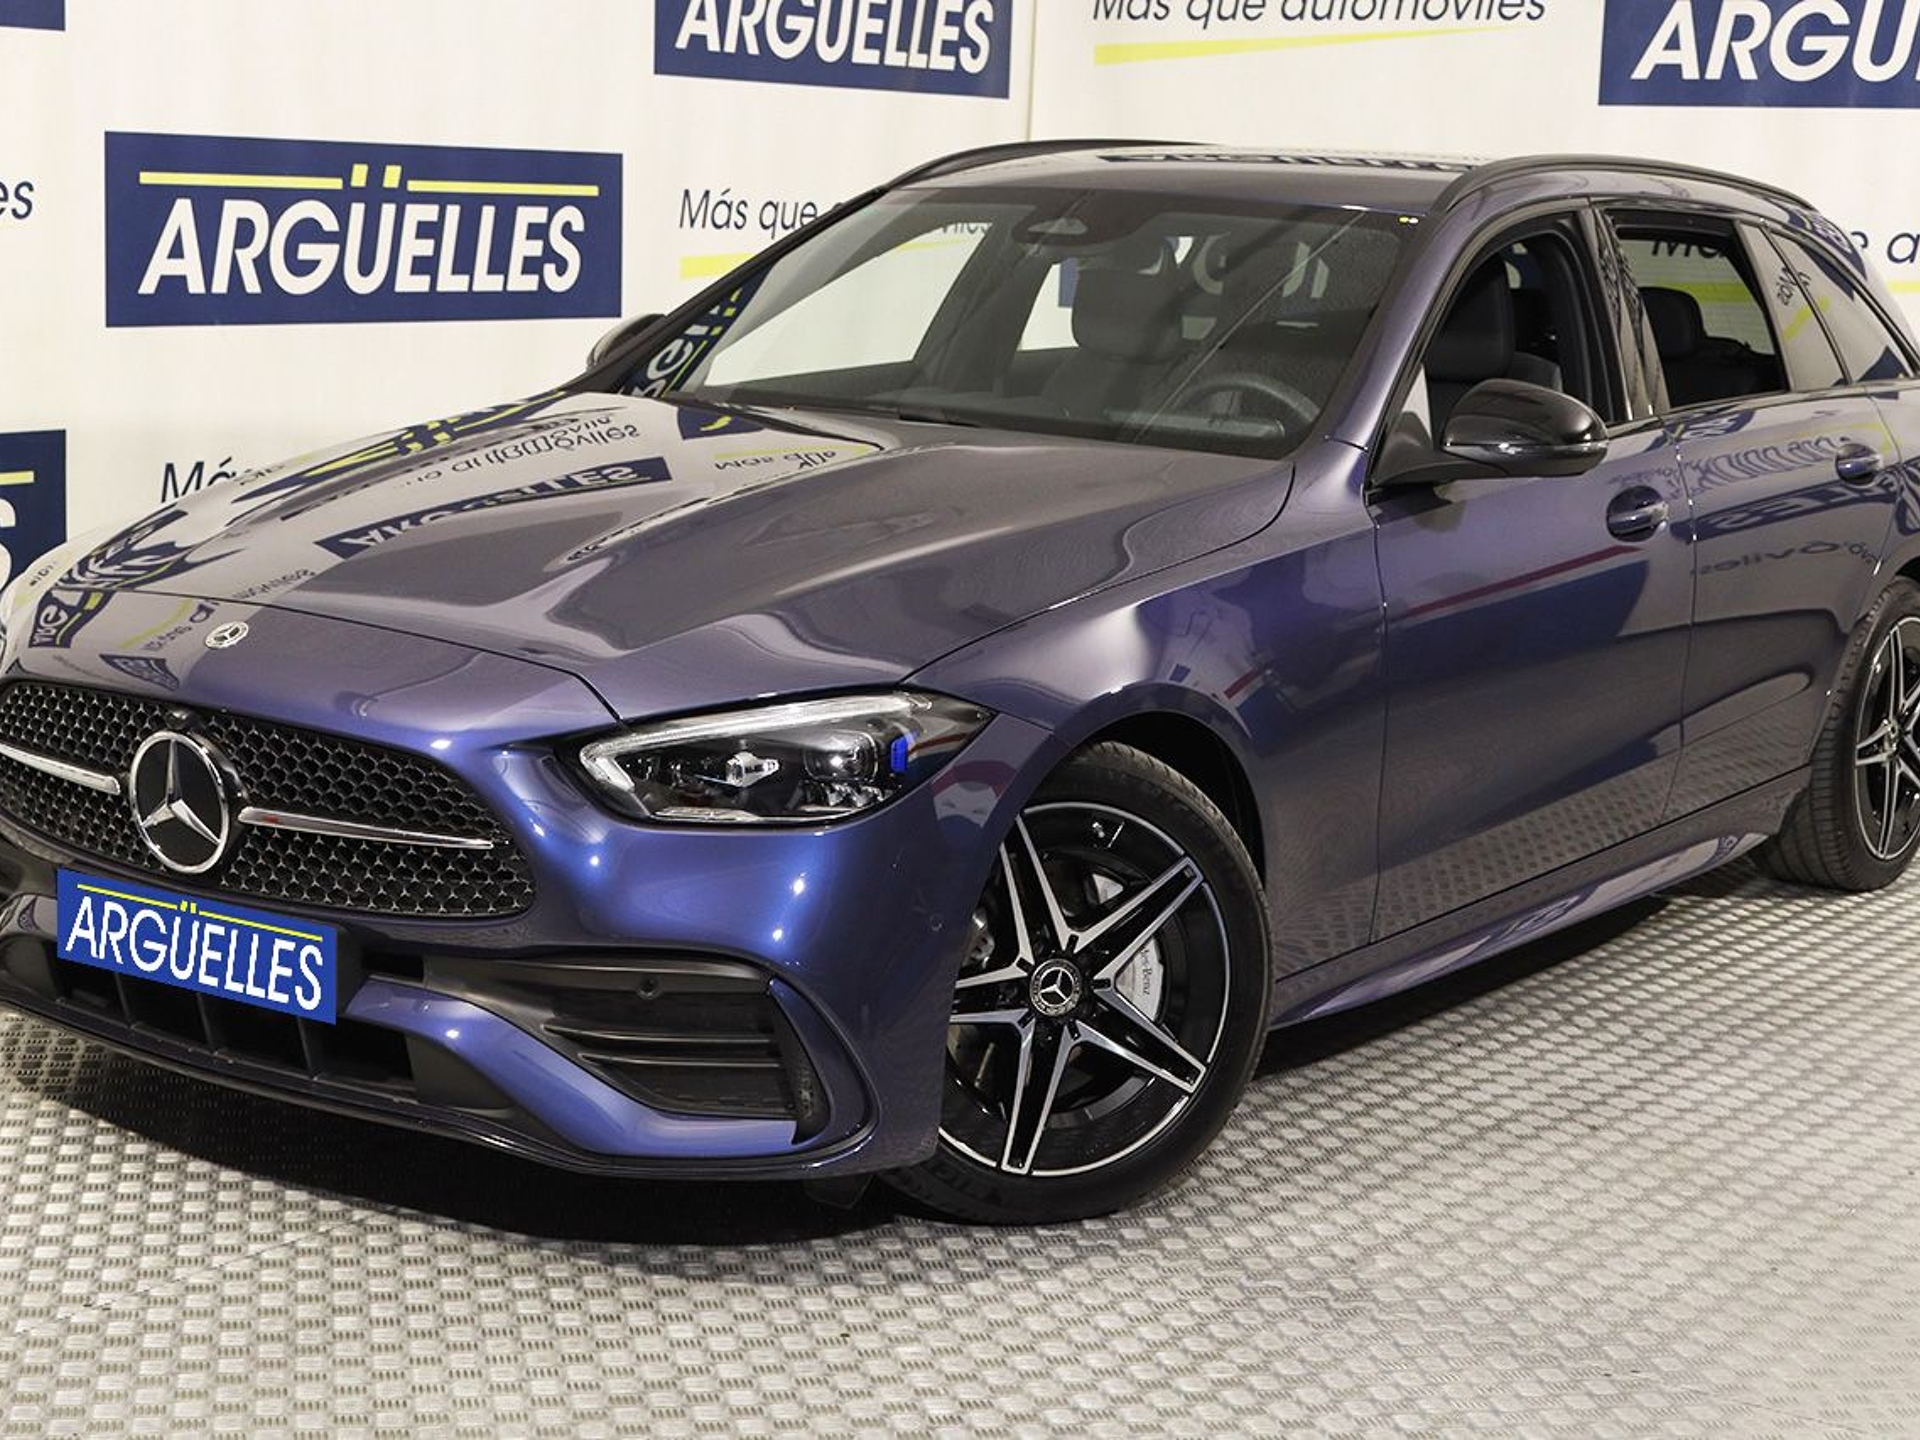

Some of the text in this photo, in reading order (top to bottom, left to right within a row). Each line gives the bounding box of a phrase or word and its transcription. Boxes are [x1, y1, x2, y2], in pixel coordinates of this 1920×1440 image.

[138, 163, 586, 295] ARGÜELLES
[679, 188, 818, 239] Más que
[65, 896, 323, 1011] ARGÜELLES
